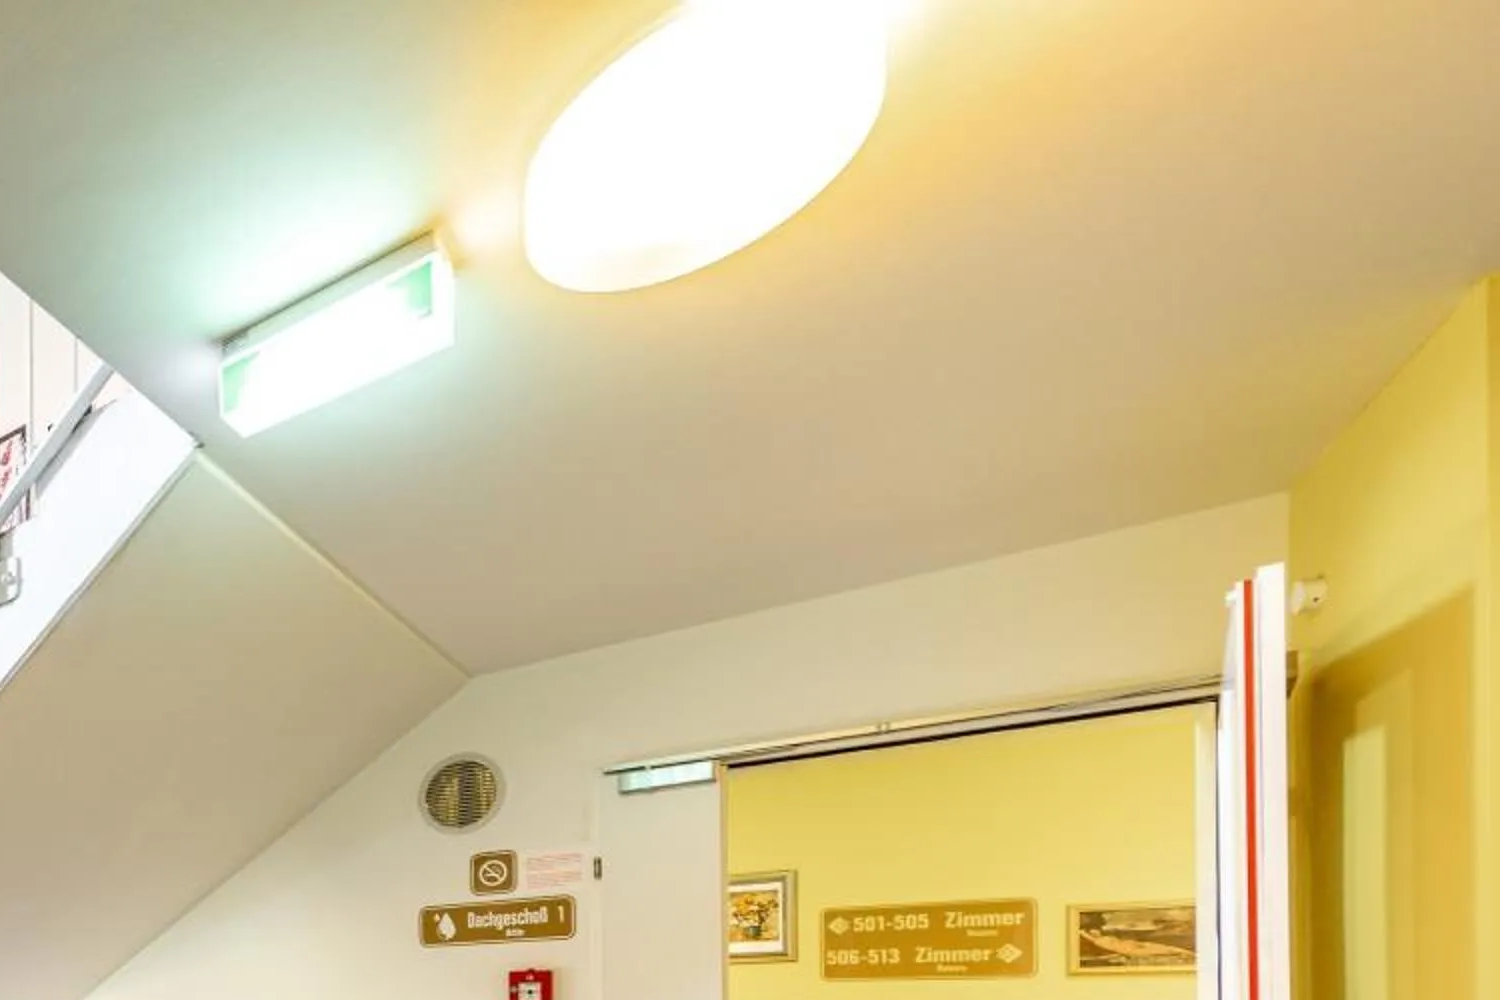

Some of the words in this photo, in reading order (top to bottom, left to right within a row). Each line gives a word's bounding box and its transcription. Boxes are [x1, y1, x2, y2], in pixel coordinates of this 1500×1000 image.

[467, 906, 549, 930] Dachgeschoß
[557, 904, 565, 923] 1
[852, 913, 930, 933] 501-505
[944, 911, 1026, 929] Zimmer
[826, 948, 901, 966] 506-513
[914, 946, 992, 964] Zimmer
